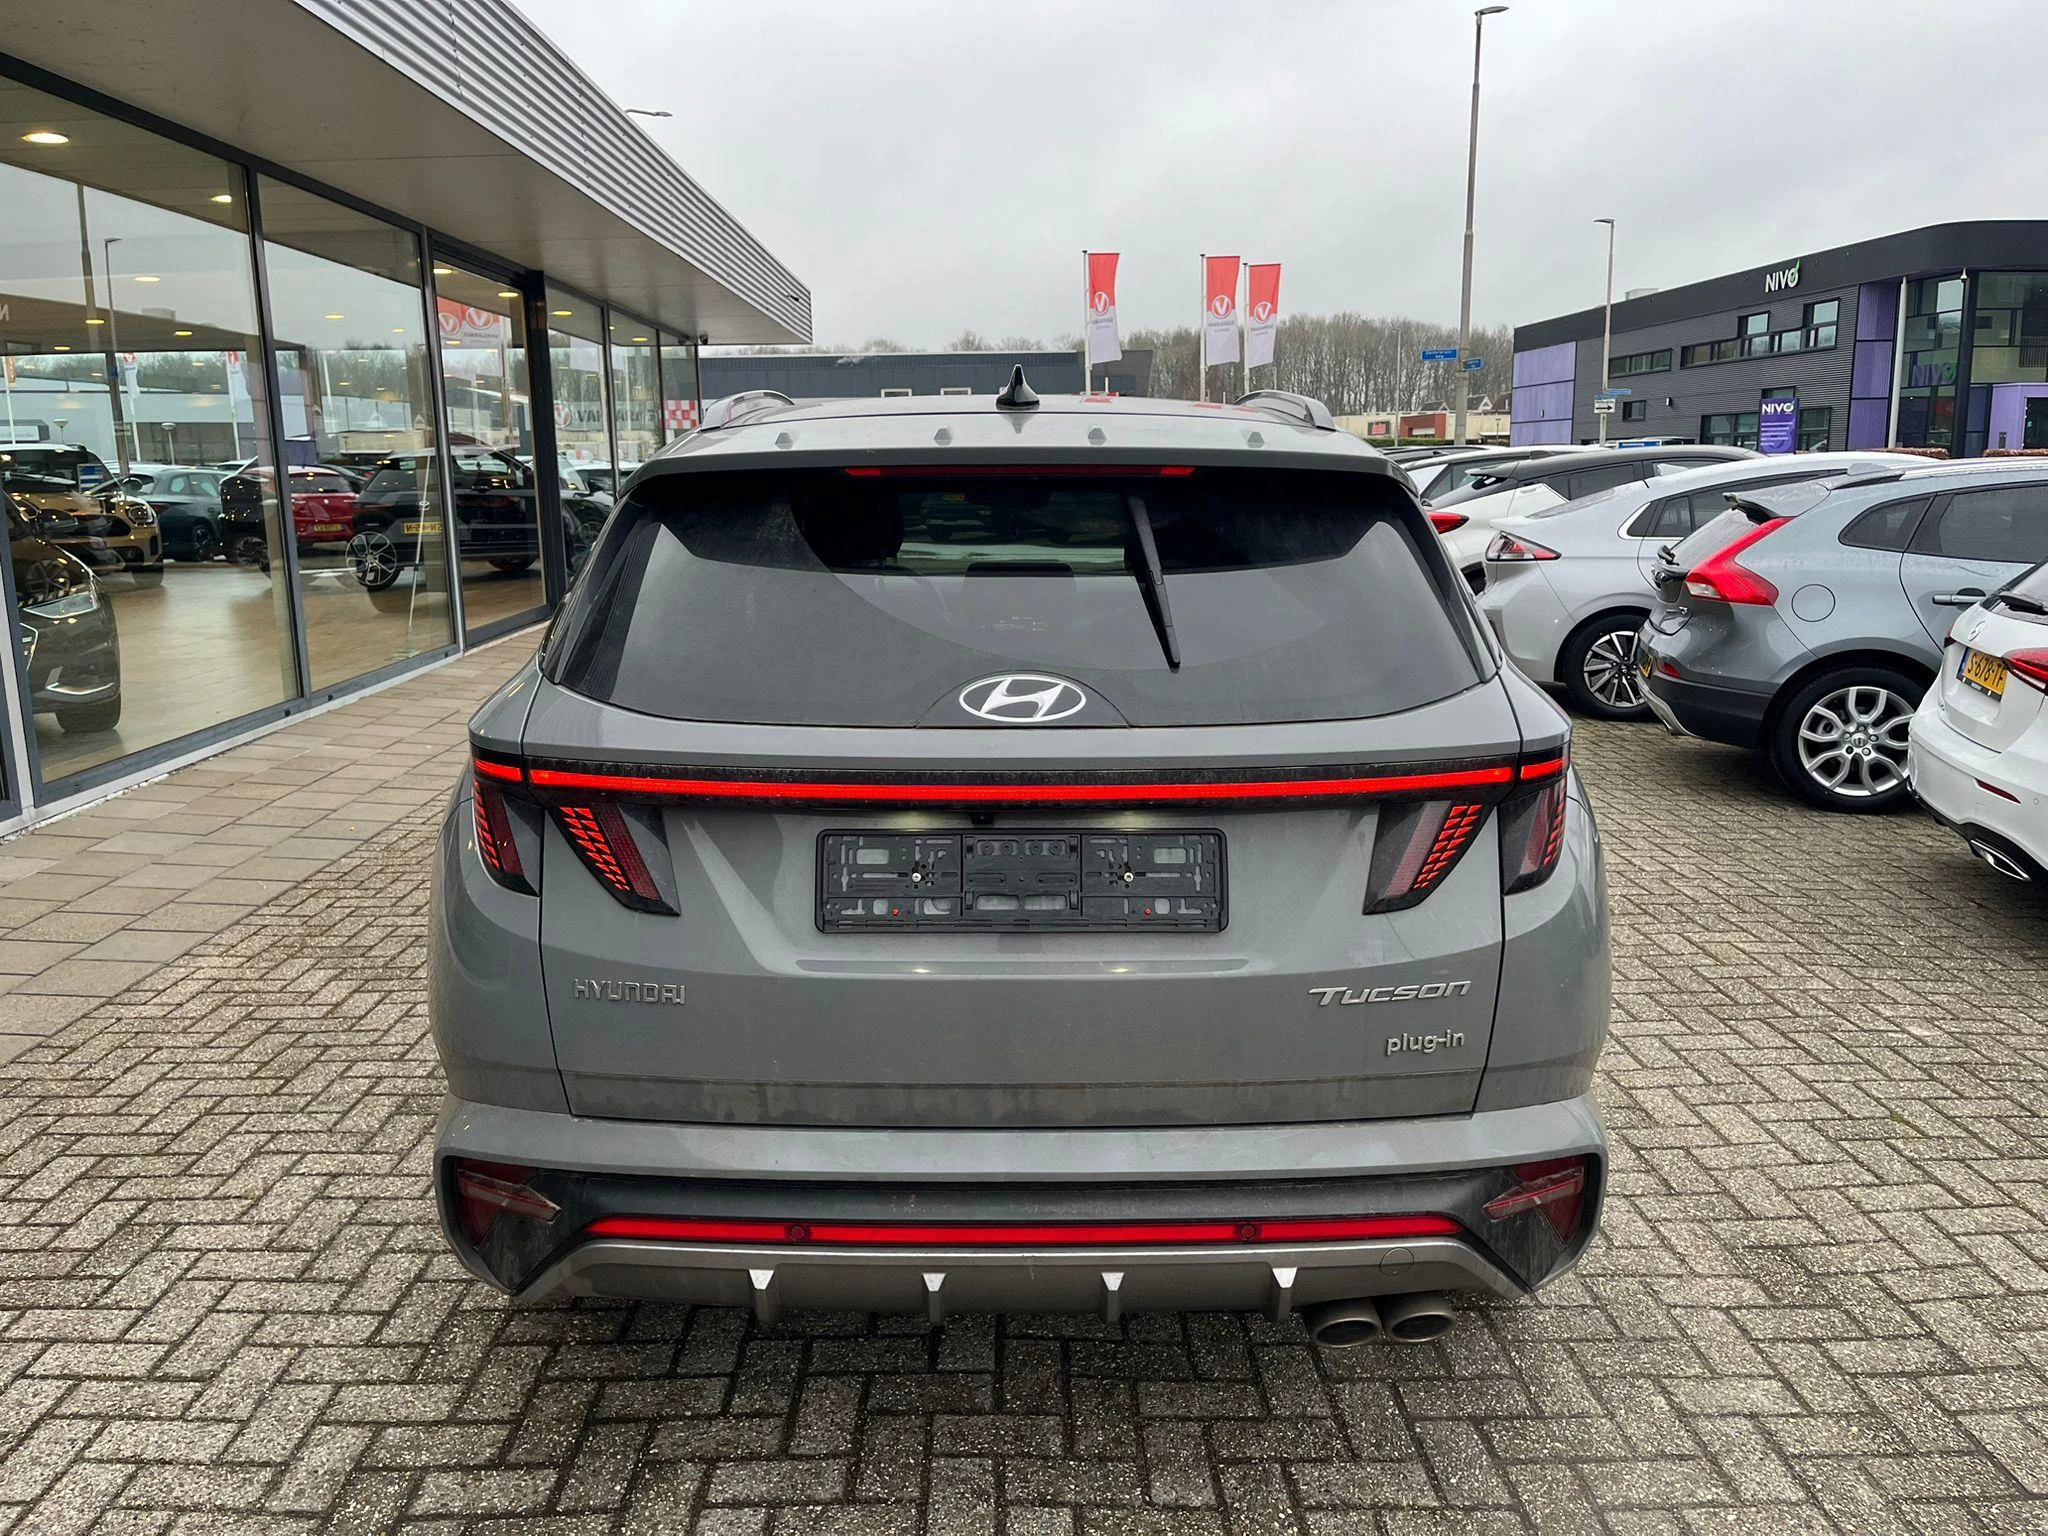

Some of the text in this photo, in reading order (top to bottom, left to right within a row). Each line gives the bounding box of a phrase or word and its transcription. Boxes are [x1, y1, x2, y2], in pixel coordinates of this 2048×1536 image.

[1765, 263, 1799, 292] NIVO
[1761, 402, 1795, 414] NIVO
[574, 978, 685, 1004] HYUNDAI
[1386, 1029, 1465, 1056] plug-in
